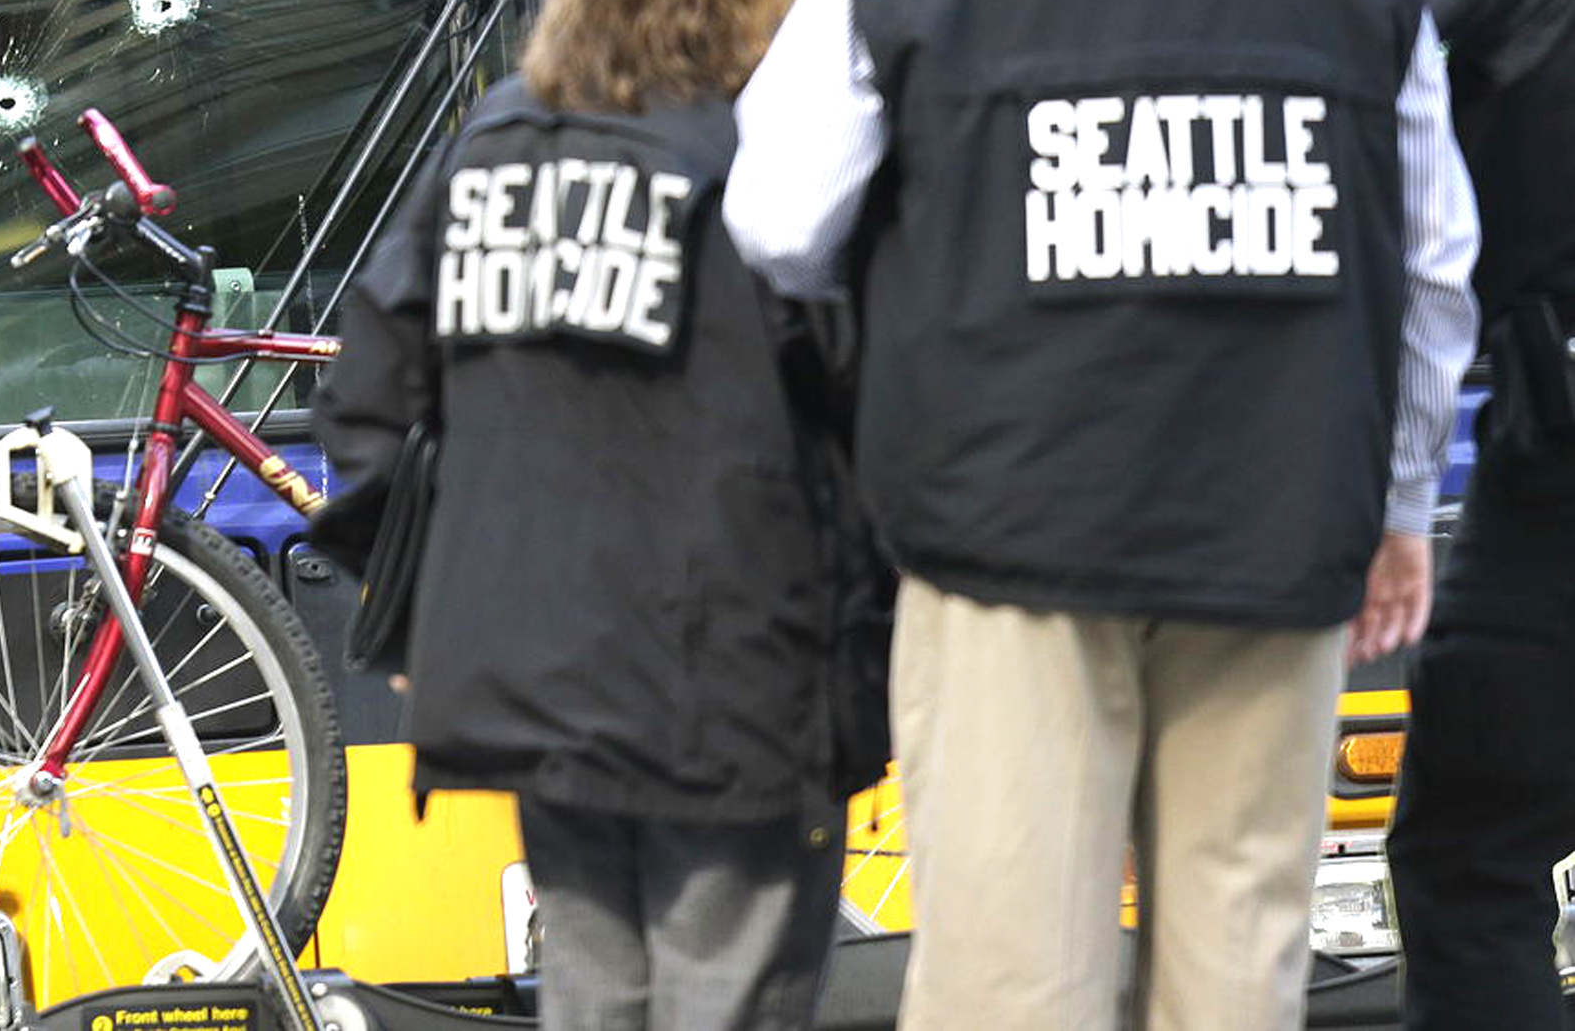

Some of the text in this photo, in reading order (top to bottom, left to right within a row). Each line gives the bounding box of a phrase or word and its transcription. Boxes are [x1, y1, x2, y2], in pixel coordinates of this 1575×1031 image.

[1027, 94, 1331, 190] SEATTLE
[445, 158, 692, 258] SEATTLE
[1026, 183, 1340, 282] HOMICIDE
[436, 236, 682, 346] HOCIDE
[115, 1009, 159, 1025] Front
[161, 1007, 209, 1023] wheel
[211, 1005, 249, 1020] here
